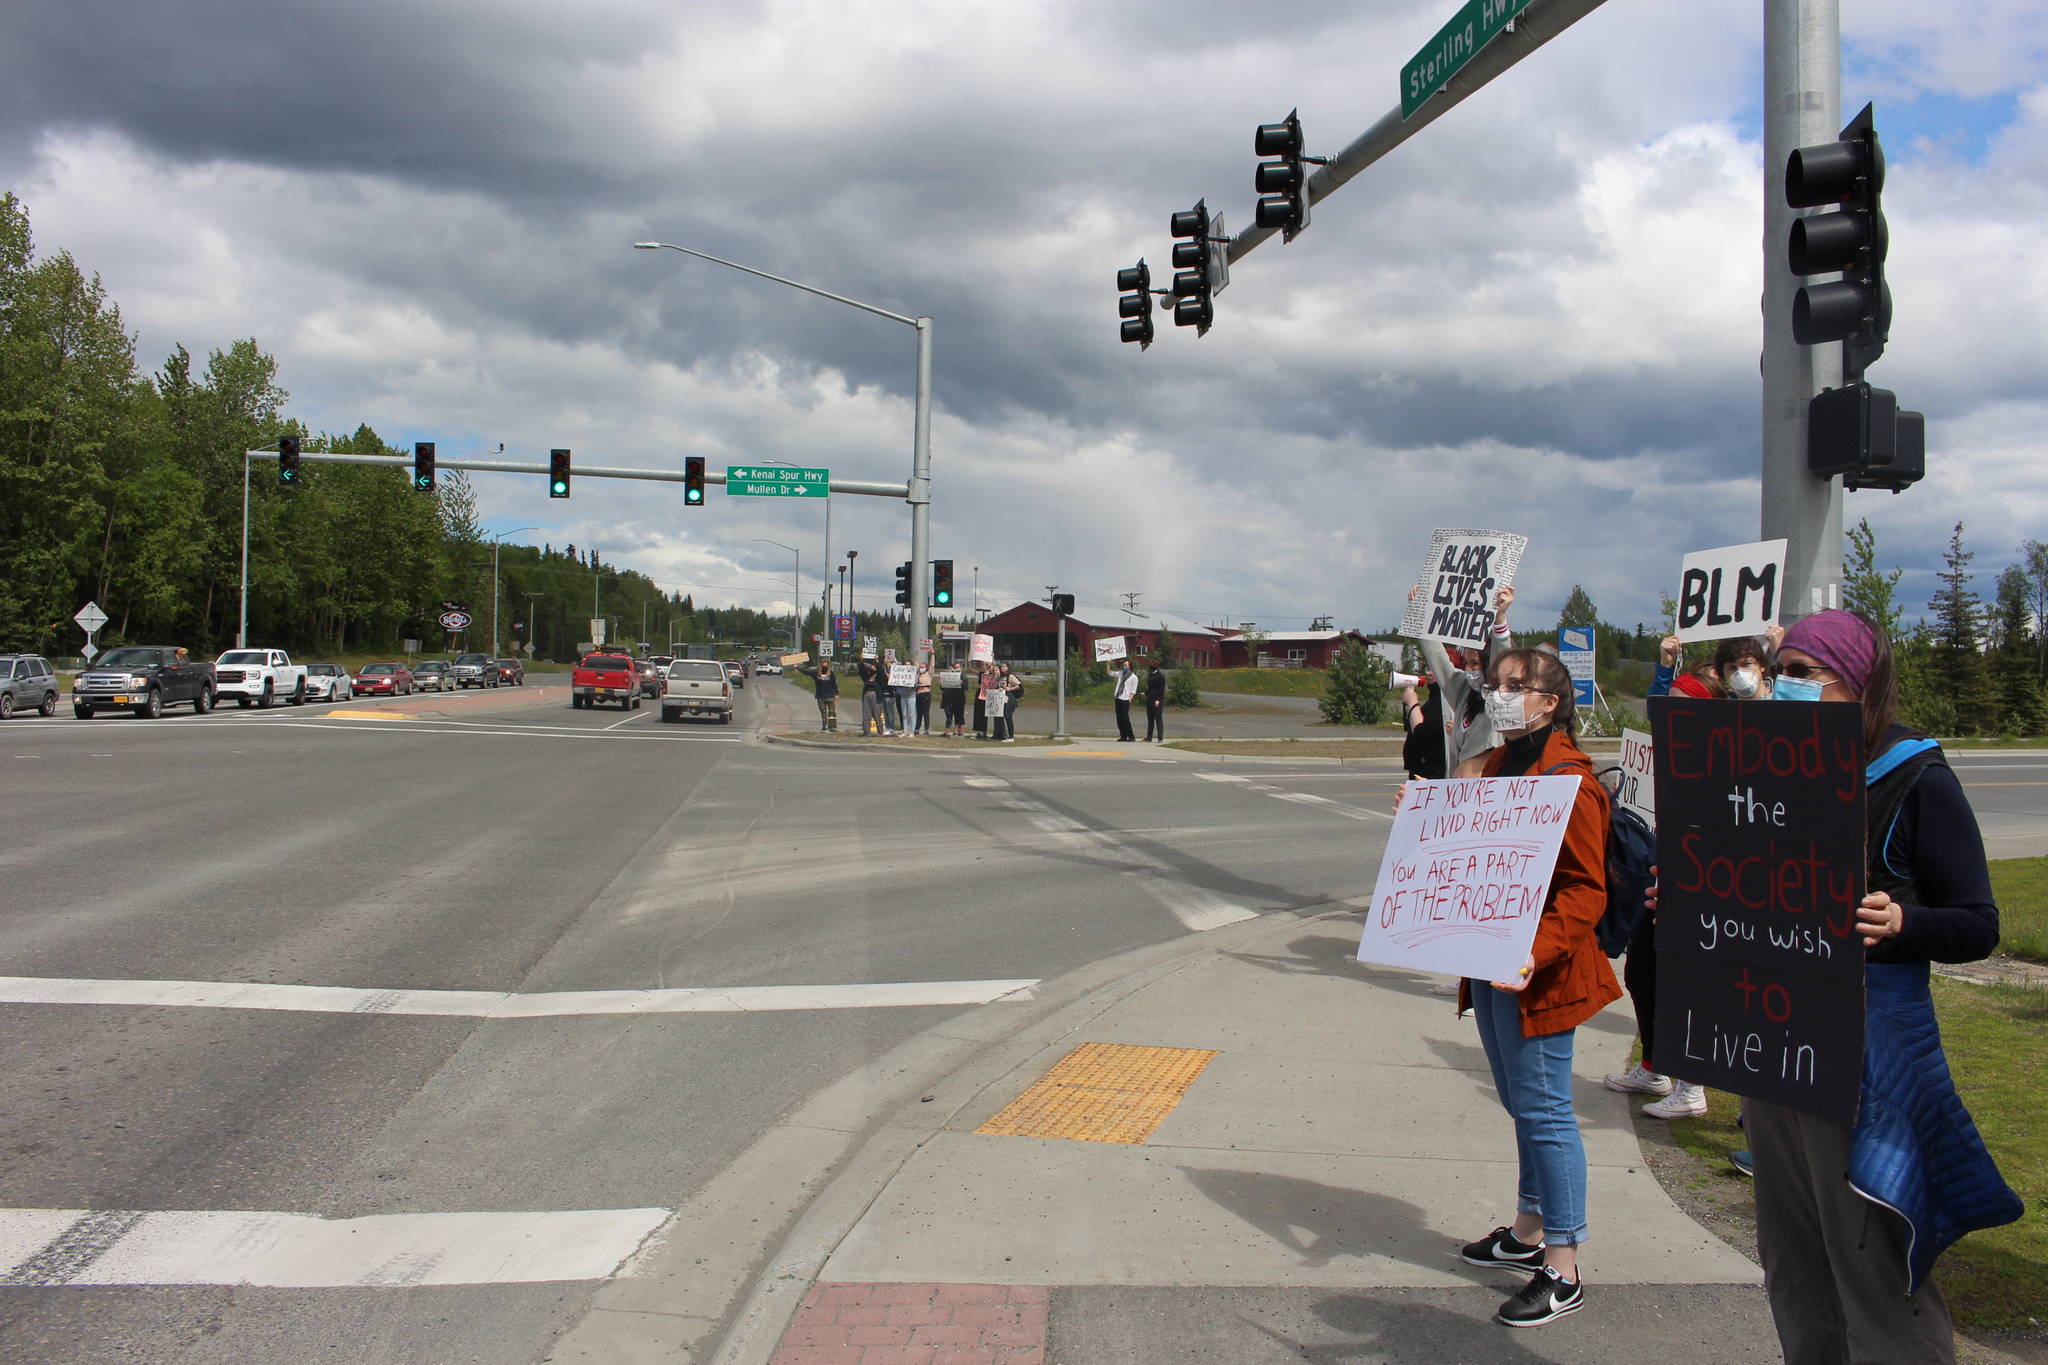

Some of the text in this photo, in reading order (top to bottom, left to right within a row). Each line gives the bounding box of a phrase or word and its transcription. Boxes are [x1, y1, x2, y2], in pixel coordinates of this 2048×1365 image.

[1410, 22, 1473, 98] Sterling
[747, 484, 791, 494] Mullen Dr
[751, 469, 823, 482] Kenai Spur Hwy
[1439, 544, 1496, 579] BLACK
[1433, 575, 1495, 610] LIVES
[1679, 563, 1776, 629] BLM
[1428, 606, 1495, 643] MATTER
[1667, 705, 1858, 802] Embody
[1408, 786, 1439, 811] IF
[1504, 779, 1540, 803] NOT
[1728, 785, 1786, 826] the
[1419, 801, 1568, 841] LIVID RIGHT NOW
[1426, 857, 1464, 883] ARE
[1465, 854, 1478, 879] A
[1485, 851, 1536, 881] PART
[1674, 833, 1856, 938] Society
[1381, 890, 1407, 929] OF
[1411, 885, 1450, 924] THE
[1700, 913, 1831, 959] you wish
[1733, 967, 1793, 1023] to
[1684, 1009, 1816, 1086] Live in
